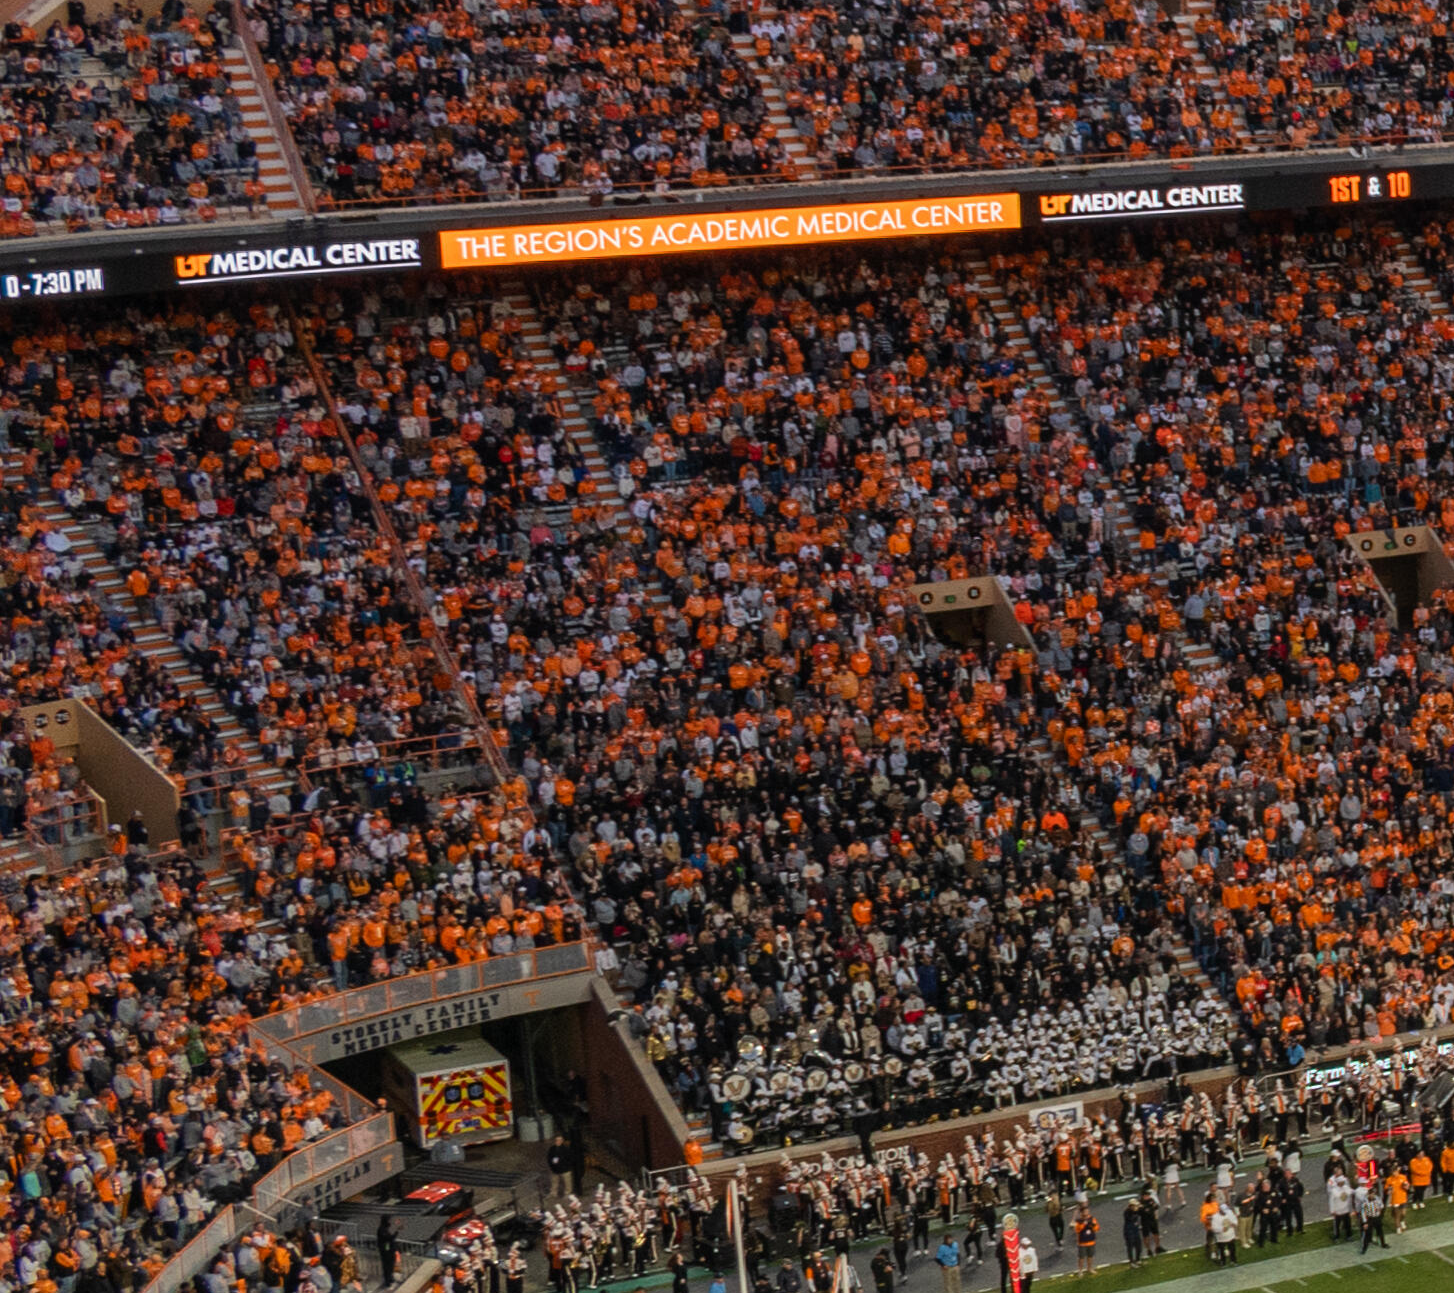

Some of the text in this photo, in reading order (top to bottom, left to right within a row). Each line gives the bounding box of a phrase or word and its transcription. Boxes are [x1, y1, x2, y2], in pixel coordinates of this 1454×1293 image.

[1071, 183, 1244, 214] MEDICAL CENTER
[1329, 175, 1361, 204] 1ST
[1367, 177, 1381, 197] &
[1387, 172, 1412, 199] 10
[458, 201, 1005, 260] THE REGION'S ACADEMIC MEDICAL CENTER
[212, 245, 321, 276] MEDICAL
[326, 238, 421, 267] CENTER
[31, 268, 104, 296] 7:30 PM
[331, 993, 501, 1046] STOKELY FAMILY
[344, 1009, 491, 1058] MEDIA CENTER
[1305, 1065, 1346, 1086] Farm
